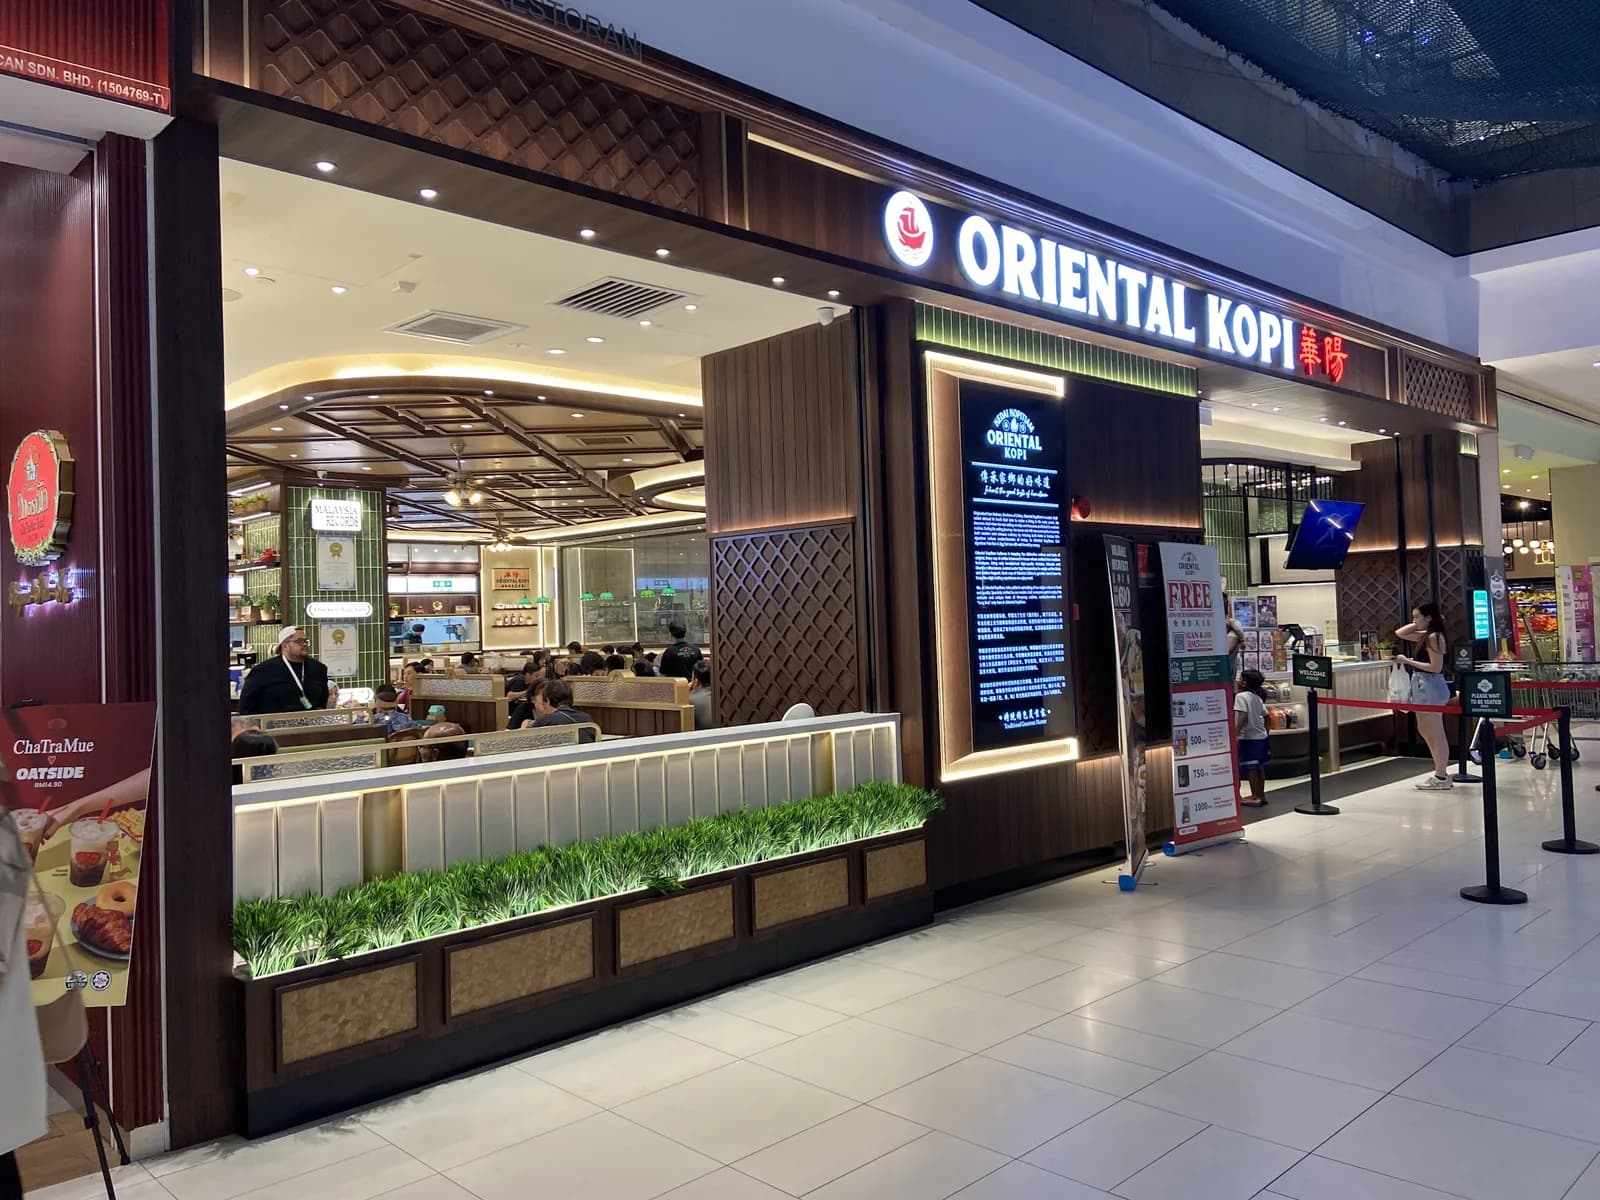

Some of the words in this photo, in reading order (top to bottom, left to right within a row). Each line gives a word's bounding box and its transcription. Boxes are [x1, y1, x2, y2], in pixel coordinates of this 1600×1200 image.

[27, 61, 59, 80] SDN.
[63, 70, 94, 89] BHD.
[97, 79, 165, 106] (1504769-T)
[958, 214, 1196, 343] ORIENTAL
[1205, 292, 1296, 371] KOPI
[1299, 325, 1348, 388] 華陽
[986, 429, 1042, 451] ORIENTAL
[1004, 447, 1027, 460] KOPI
[1168, 582, 1212, 609] FREE
[1298, 669, 1326, 678] WELCOME
[1188, 702, 1199, 713] 300
[13, 738, 95, 755] ChaTraMue
[1190, 735, 1202, 745] 500
[16, 766, 85, 781] OATSIDE
[1192, 768, 1204, 779] 750
[1195, 802, 1209, 812] 1000
